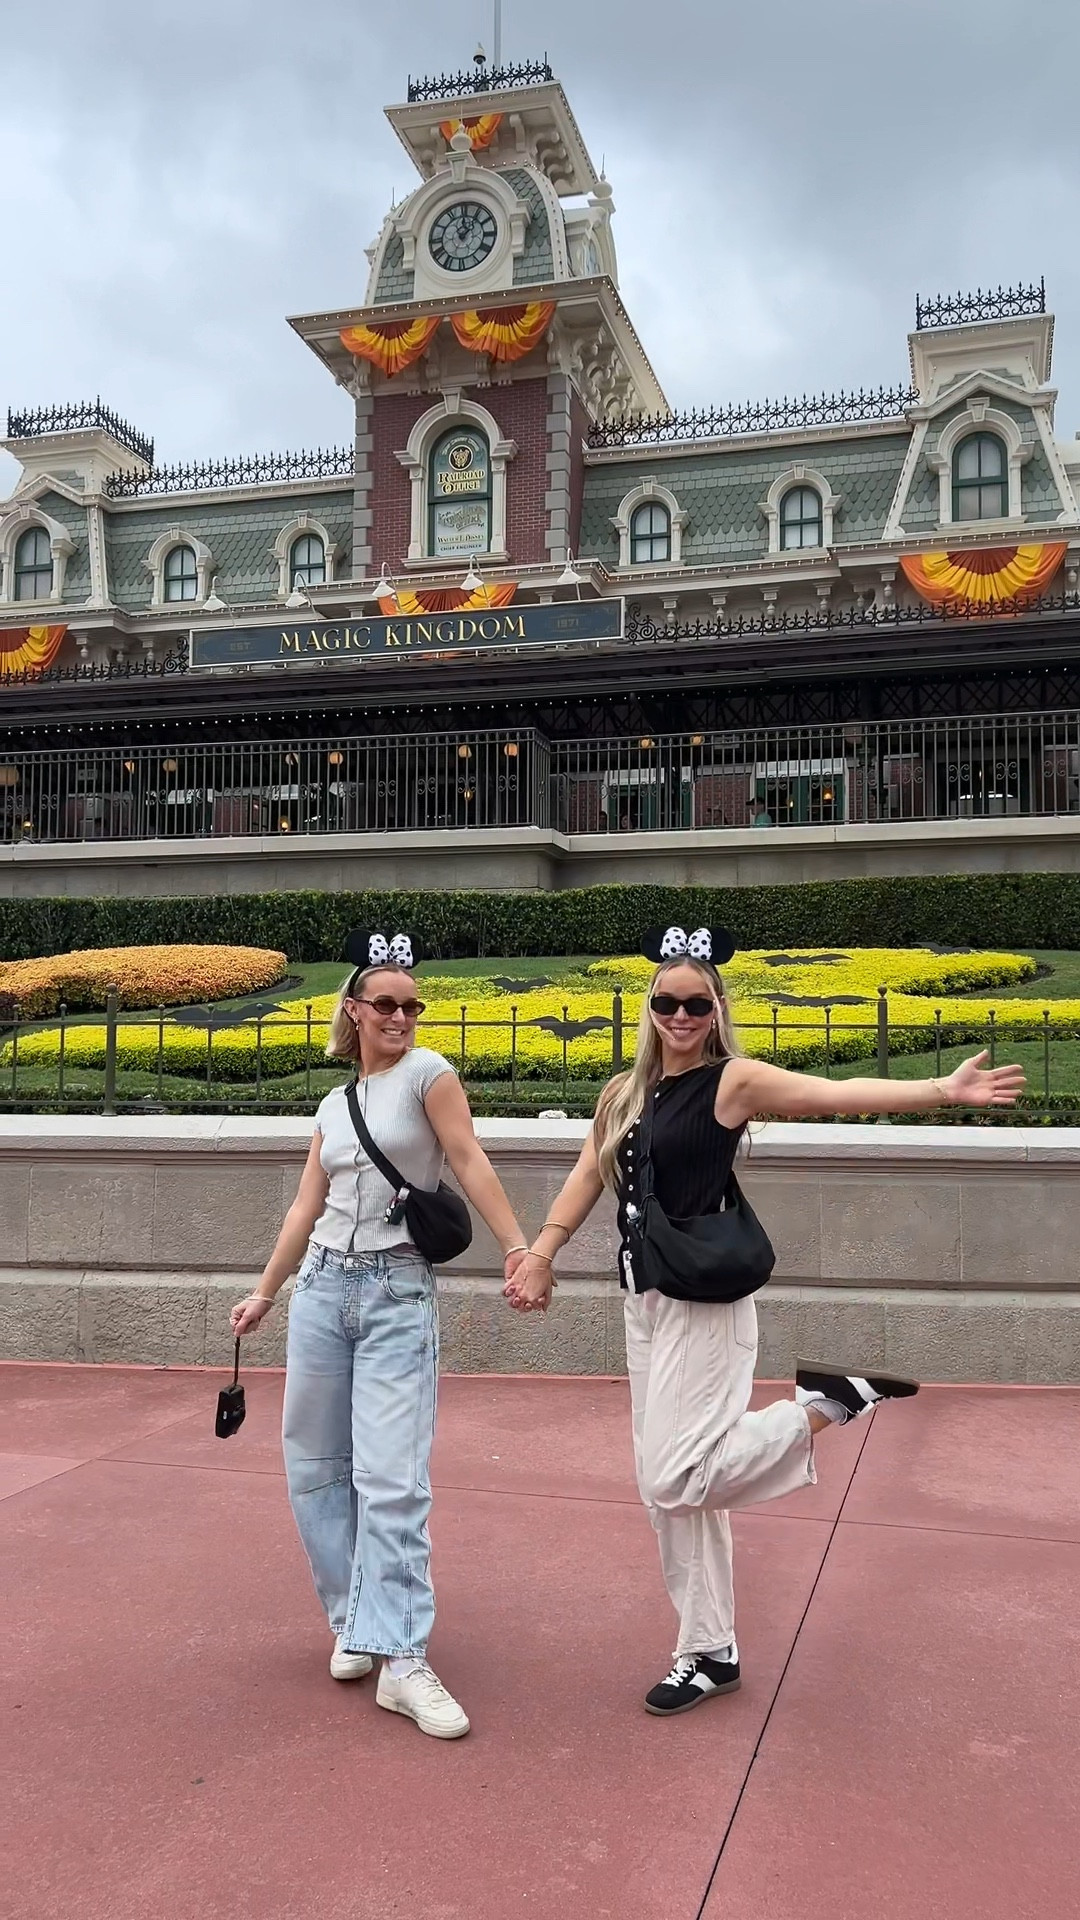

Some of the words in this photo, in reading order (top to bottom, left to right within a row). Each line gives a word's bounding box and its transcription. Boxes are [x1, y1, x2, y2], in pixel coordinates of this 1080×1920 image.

[438, 470, 485, 484] RAILROAD
[442, 481, 481, 494] OFFICE
[278, 626, 371, 654] MAGIC
[385, 614, 526, 647] KINGDOM
